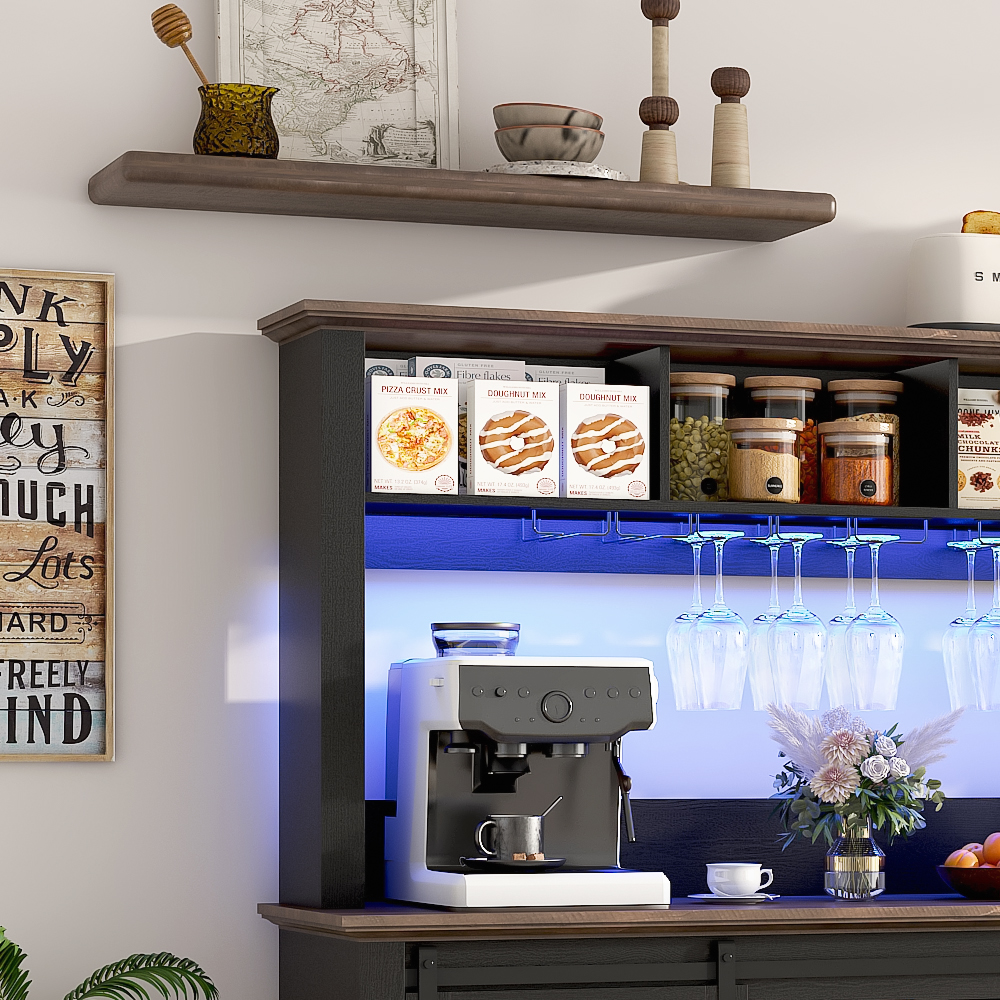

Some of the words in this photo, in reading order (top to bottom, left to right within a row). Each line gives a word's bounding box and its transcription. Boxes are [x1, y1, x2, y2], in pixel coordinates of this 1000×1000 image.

[457, 370, 481, 380] Fibre
[483, 371, 511, 381] flakes
[405, 386, 431, 394] CRUST
[433, 387, 448, 395] MIX
[488, 389, 530, 398] DOUGHNUT
[532, 391, 546, 399] MIX
[580, 393, 621, 402] DOUGHNUT
[3, 536, 94, 589] Lots
[0, 612, 68, 632] ARD
[0, 659, 89, 690] REELY
